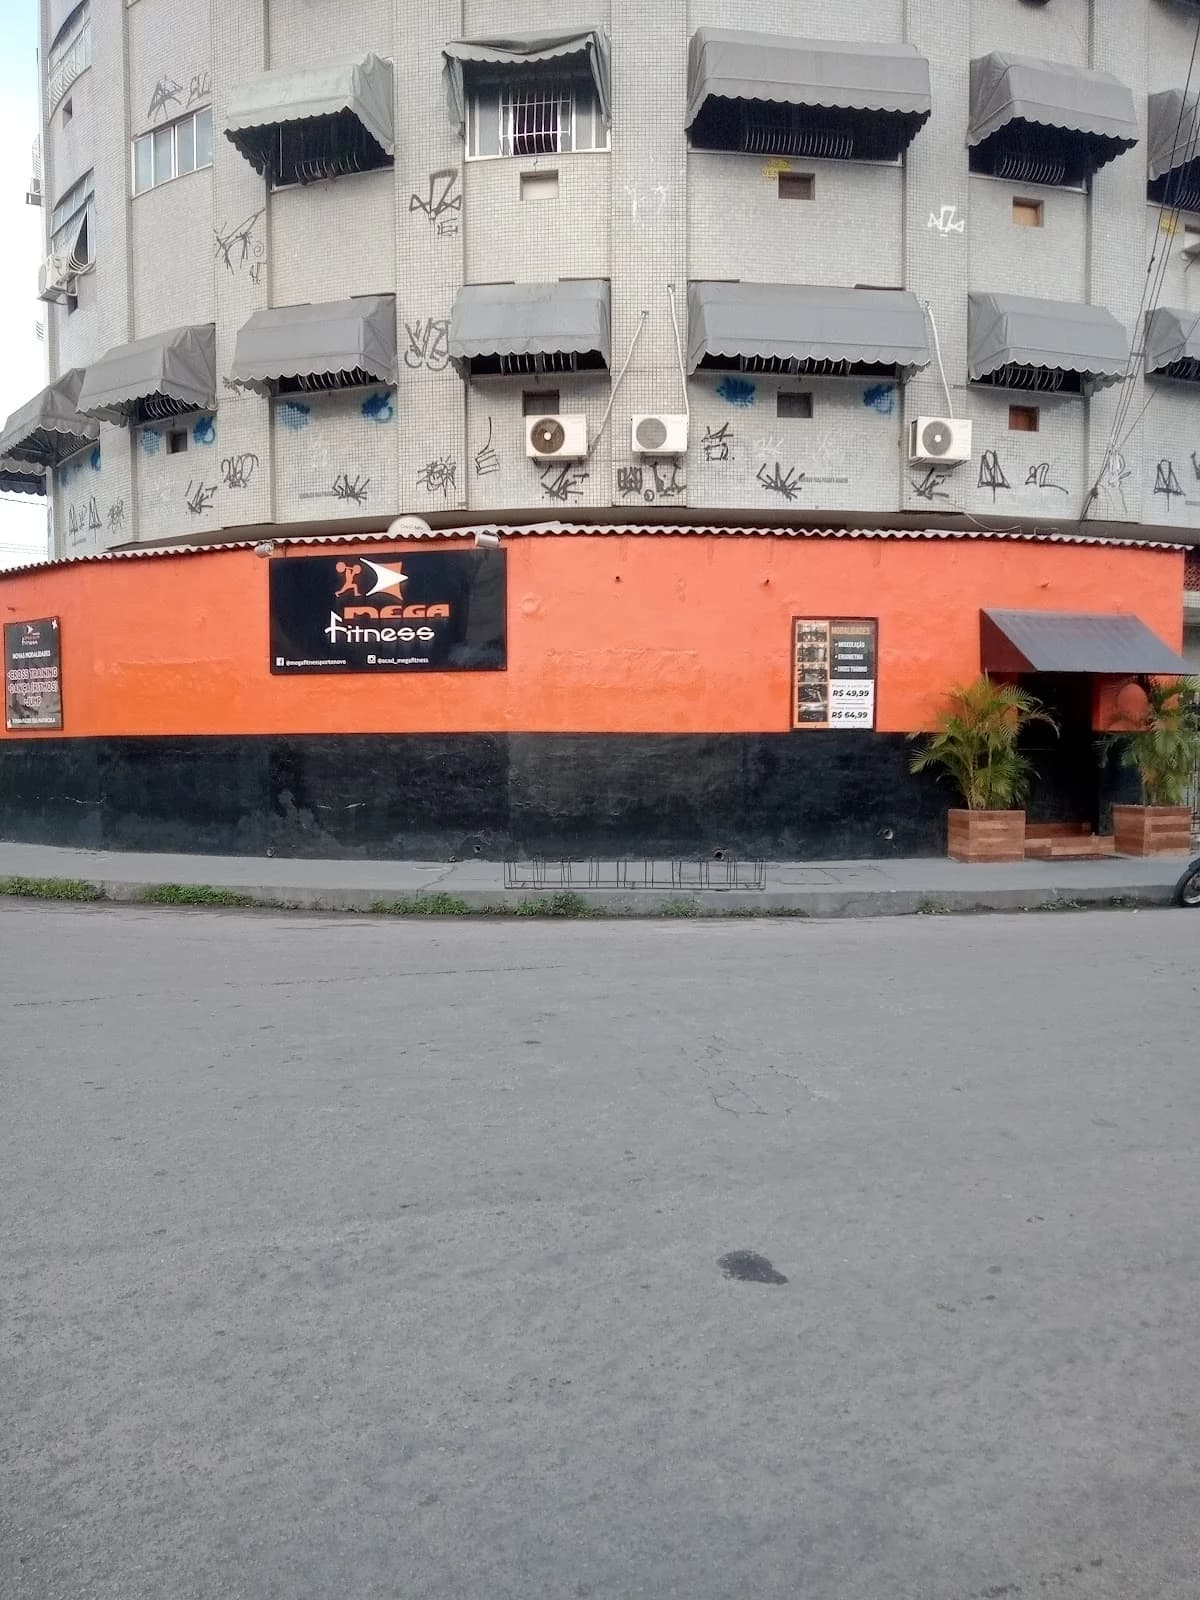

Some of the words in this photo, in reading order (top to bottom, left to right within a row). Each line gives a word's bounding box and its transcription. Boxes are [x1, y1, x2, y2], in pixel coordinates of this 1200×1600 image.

[344, 604, 450, 619] MEGA
[846, 689, 870, 698] 49,99
[832, 711, 842, 719] R$
[844, 711, 868, 719] 64,99
